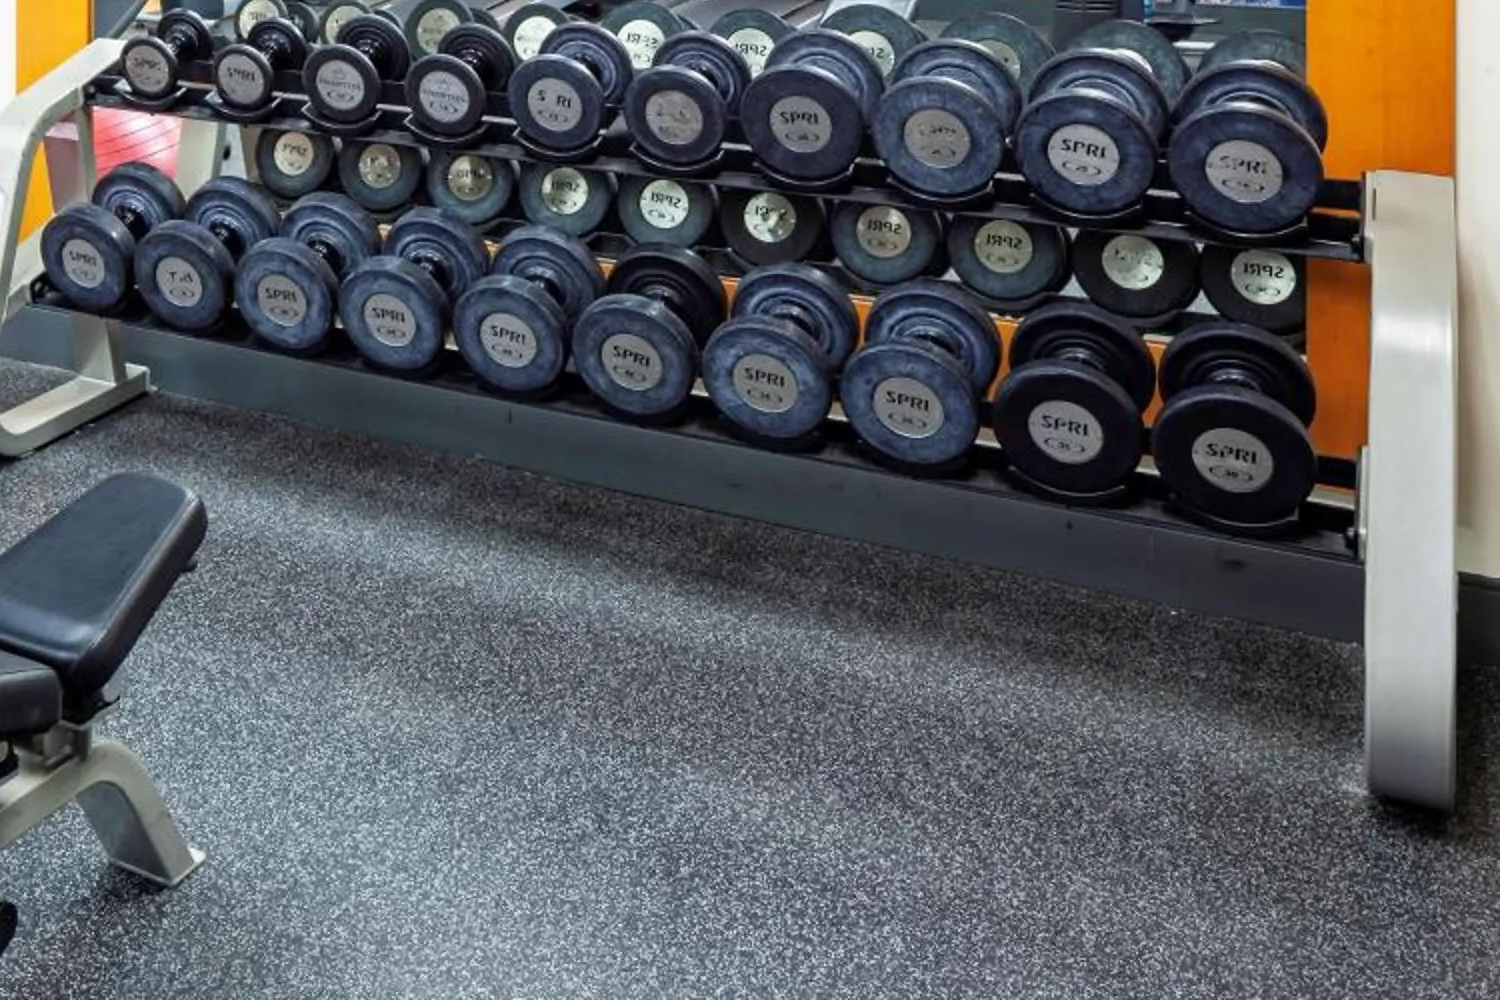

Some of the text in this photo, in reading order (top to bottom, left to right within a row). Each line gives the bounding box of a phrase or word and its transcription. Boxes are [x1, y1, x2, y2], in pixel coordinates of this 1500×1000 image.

[537, 90, 571, 108] SRI
[780, 111, 819, 125] SPRI
[1061, 138, 1106, 159] SPRI
[265, 287, 297, 302] SPRI
[372, 306, 406, 323] SPRI
[490, 325, 527, 346] SPRI
[612, 345, 651, 369] SPRI
[744, 366, 786, 388] SPRI
[886, 390, 930, 412] SPRI
[1041, 414, 1090, 437] SPRI
[1206, 442, 1258, 465] SPRI
